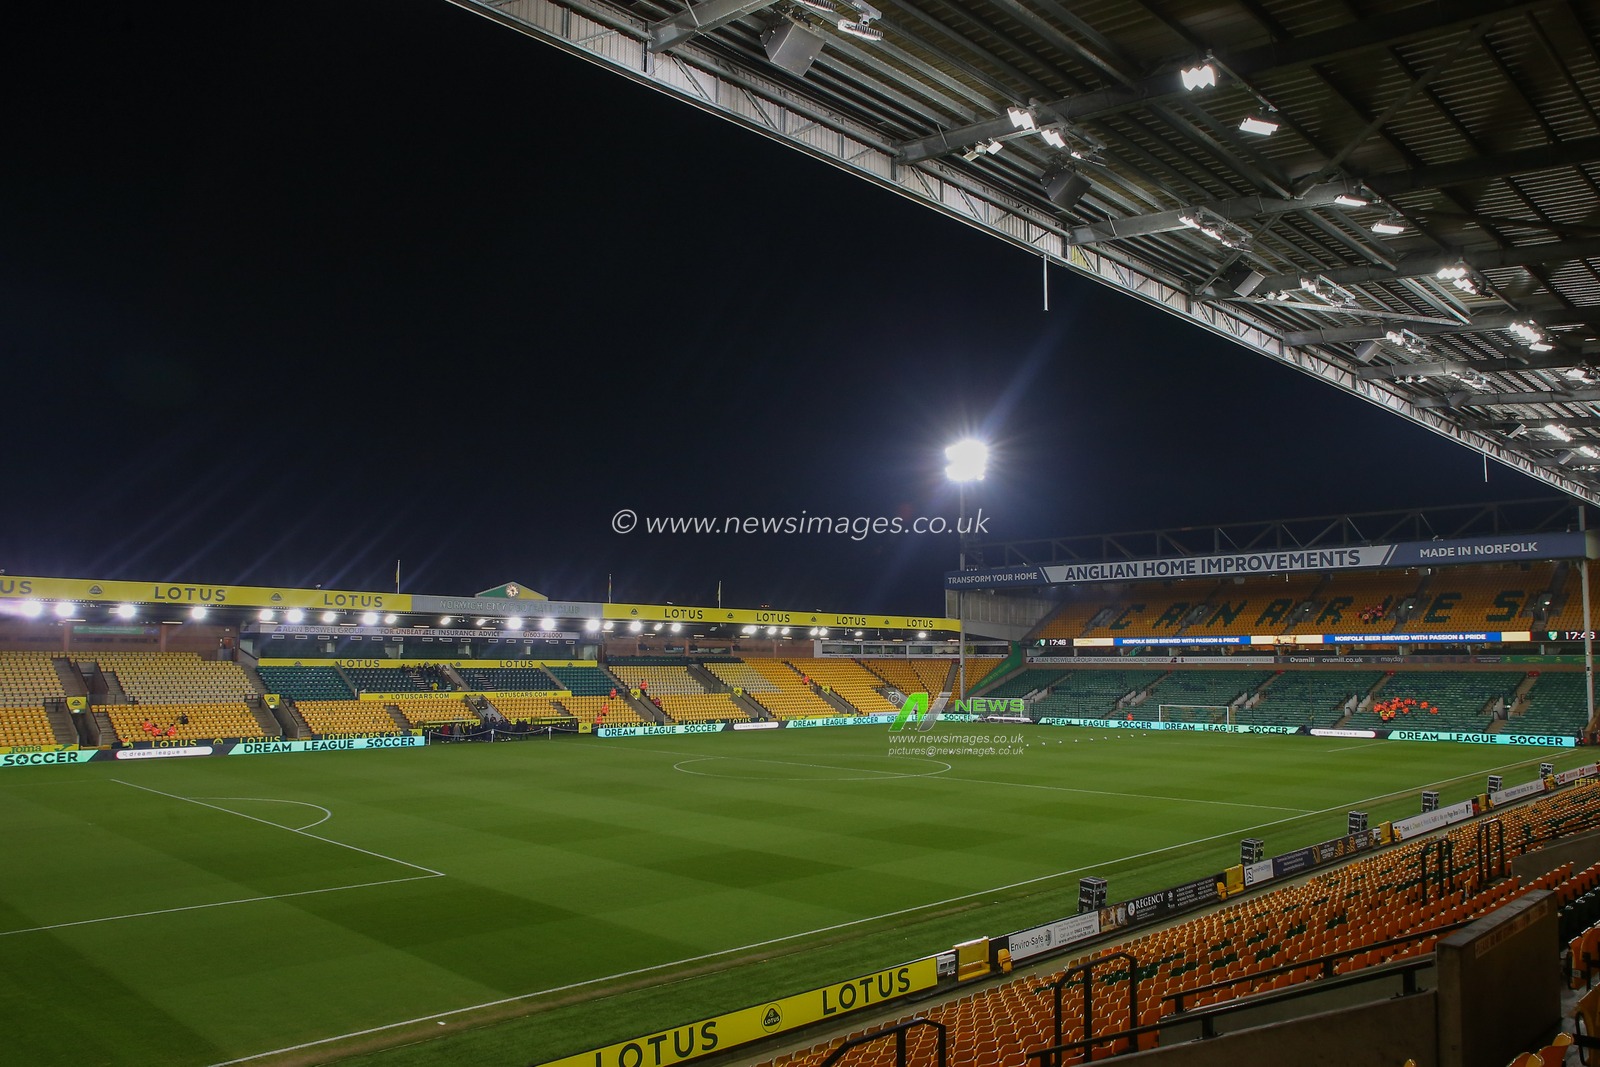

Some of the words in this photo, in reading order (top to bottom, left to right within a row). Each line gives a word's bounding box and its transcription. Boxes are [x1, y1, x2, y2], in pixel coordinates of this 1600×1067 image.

[1420, 547, 1455, 558] MADE
[1458, 547, 1471, 556] IN
[1475, 541, 1538, 555] NORFOLK
[1065, 563, 1138, 580] ANGLIAN
[1143, 559, 1196, 577] HOME
[1201, 549, 1361, 574] IMPROVEMENTS
[948, 574, 991, 584] TRANSFORM
[991, 573, 1013, 582] YOUR
[1014, 572, 1038, 581] HOME
[154, 586, 226, 602] LOTUS
[324, 593, 383, 608] LOTUS
[439, 600, 483, 611] NORWICH
[486, 602, 507, 612] CITY
[557, 605, 581, 615] CLUB
[664, 608, 703, 620] LOTUS
[756, 612, 790, 622] LOTUS
[836, 615, 866, 626] LOTUS
[906, 619, 933, 628] LOTUS
[282, 625, 302, 633] ALAN
[304, 626, 337, 634] BOSWELL
[338, 627, 364, 635] GROUP
[339, 660, 380, 668] LOTUS
[500, 660, 533, 668] LOTUS
[1380, 656, 1404, 664] mayday
[822, 718, 848, 726] LEAGUE
[852, 717, 879, 725] SOCCER
[1045, 718, 1072, 726] DREAM
[1079, 719, 1110, 727] LEAGUE
[1117, 721, 1152, 729] SOCCER
[605, 728, 636, 737] DREAM
[643, 727, 677, 735] LEAGUE
[684, 724, 717, 733] SOCCER
[1164, 722, 1195, 730] DREAM
[1203, 724, 1239, 732] LEAGUE
[1248, 725, 1289, 734] SOCCER
[152, 739, 197, 748] LOTUS
[240, 736, 281, 744] LOTUS
[1399, 731, 1439, 741] DREAM
[1449, 733, 1497, 743] LEAGUE
[1509, 735, 1564, 746] SOCCER
[243, 741, 292, 754] DREAM
[304, 739, 355, 751] LEAGUE
[366, 737, 416, 749] SOCCER
[2, 751, 78, 766] SOCCER
[1135, 892, 1165, 910] REGENCY
[1010, 934, 1044, 952] Enviro-Safe
[822, 967, 911, 1016] LOTUS
[764, 1016, 780, 1025] LOTUS
[595, 1021, 718, 1067] LOTUS
